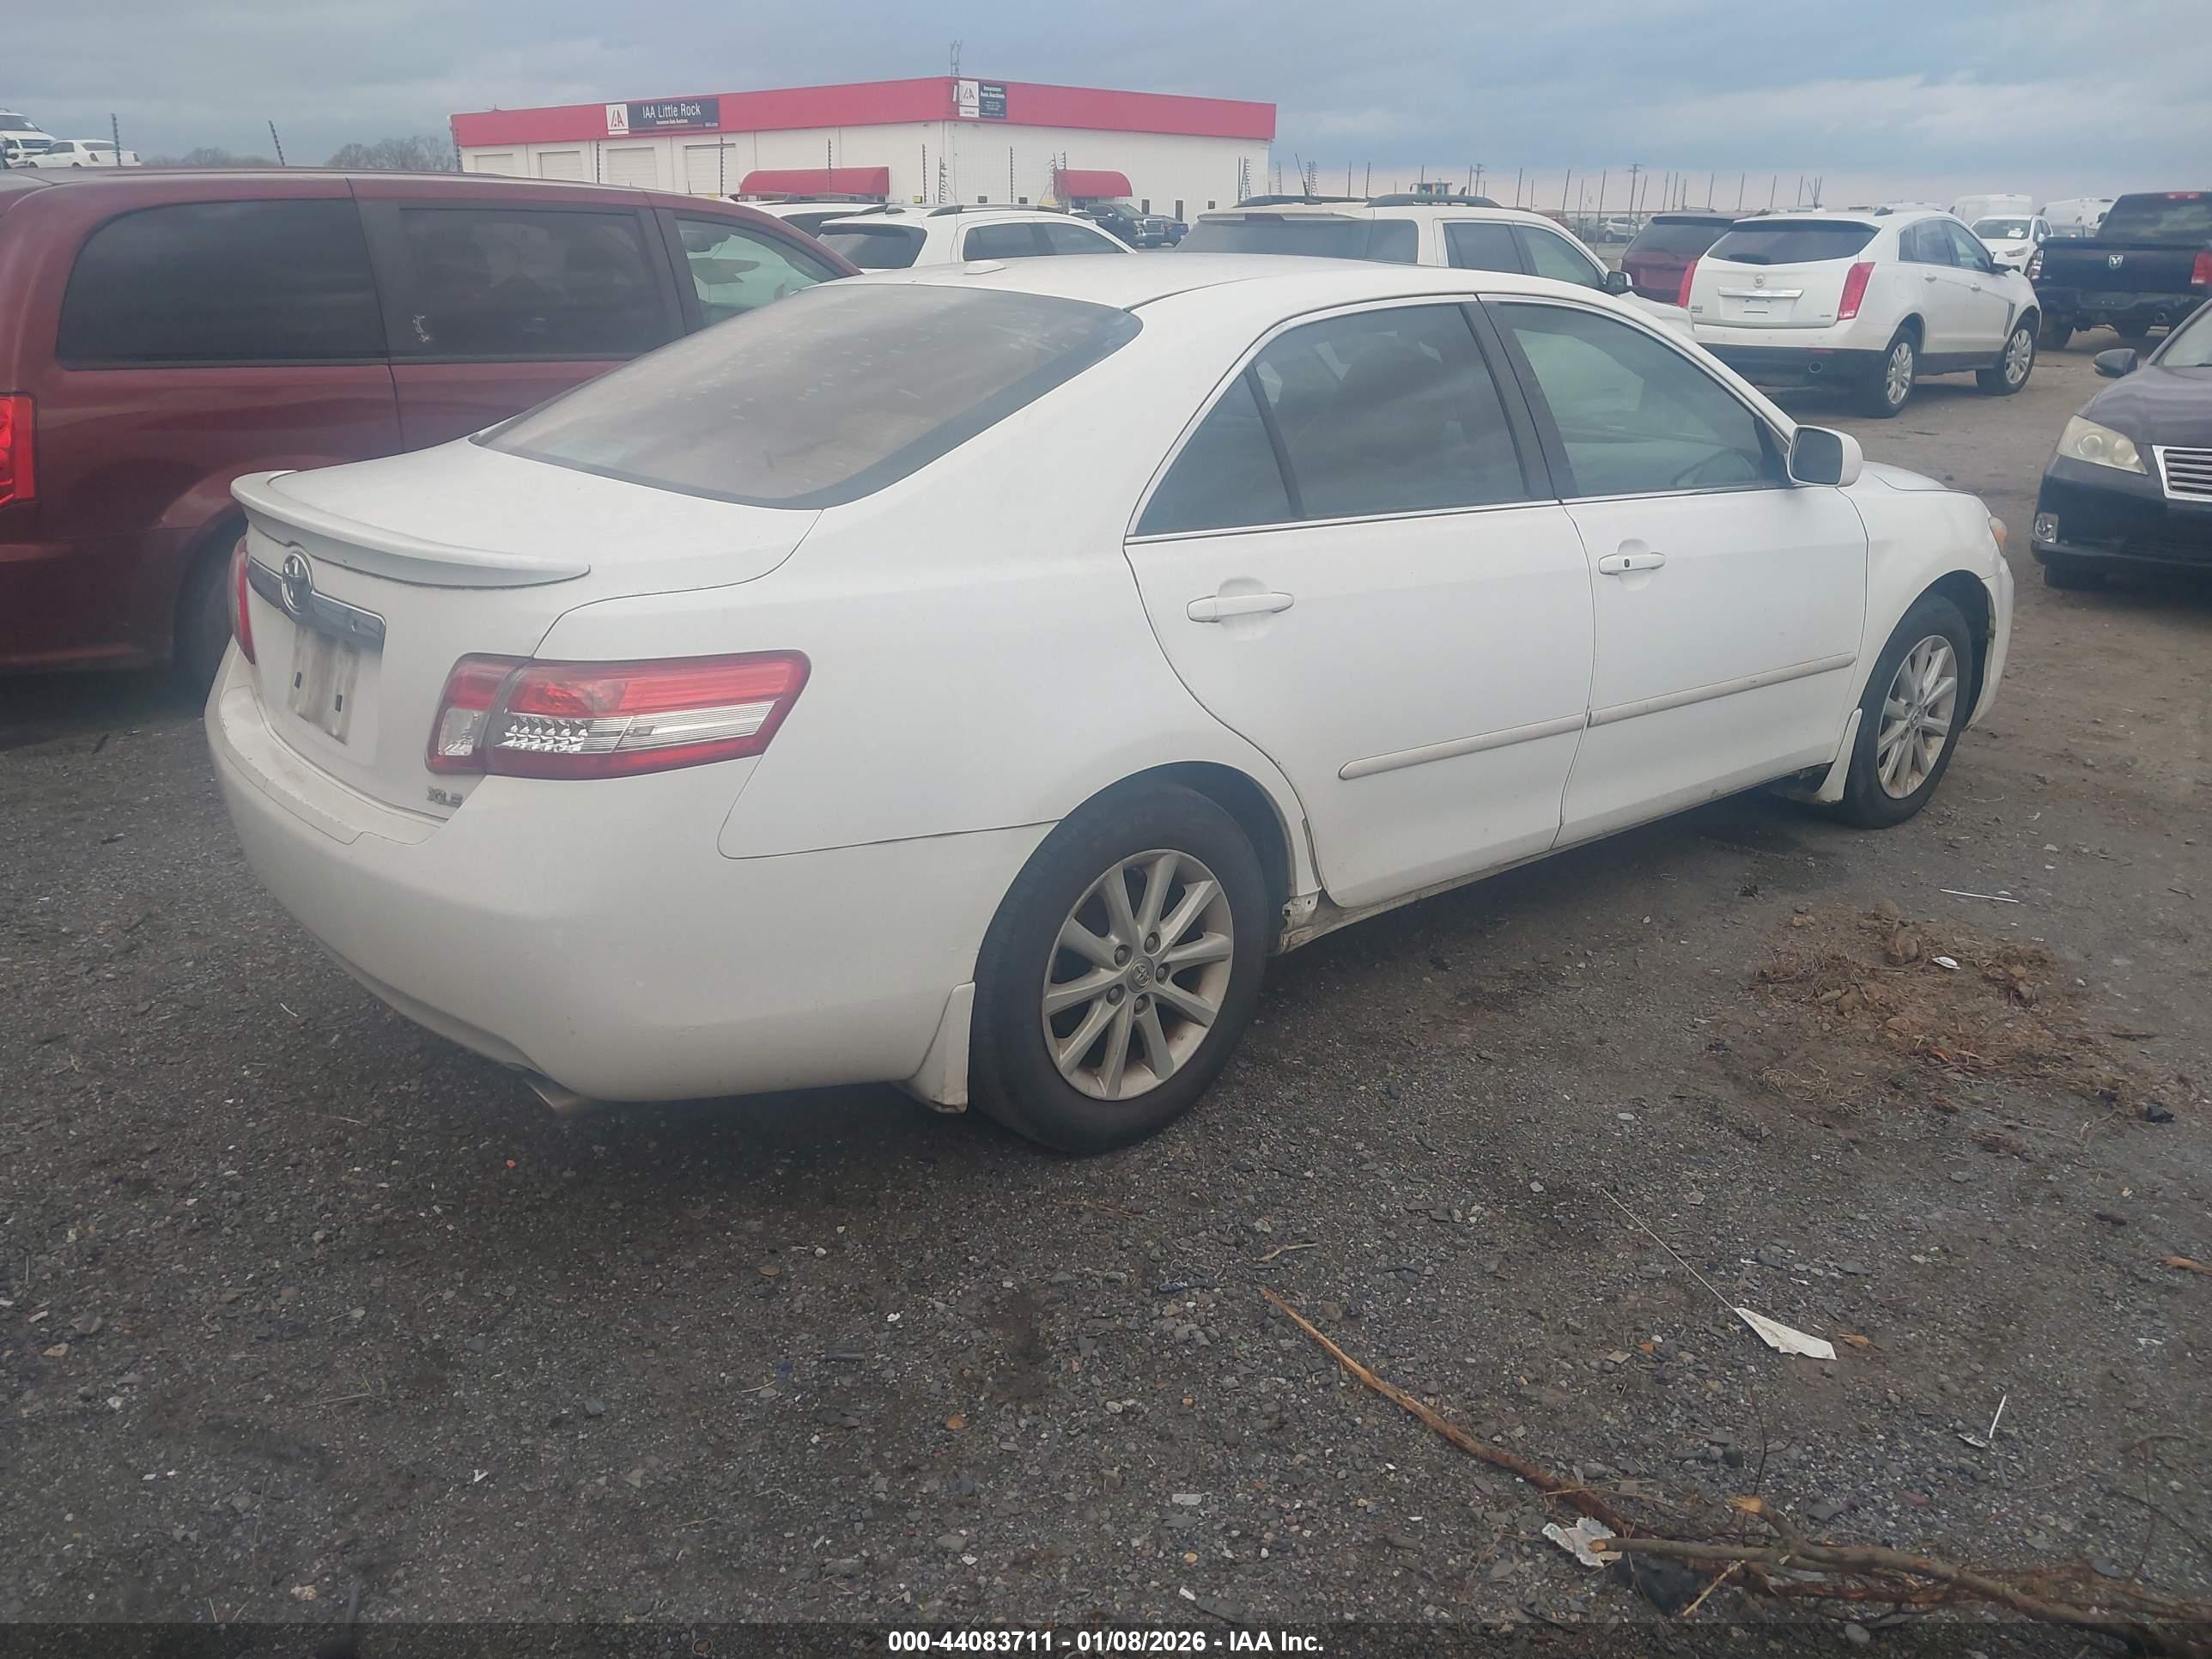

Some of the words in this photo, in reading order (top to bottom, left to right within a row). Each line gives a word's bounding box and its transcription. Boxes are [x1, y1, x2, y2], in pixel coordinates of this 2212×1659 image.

[642, 106, 656, 118] IAA
[658, 104, 678, 118] Little
[681, 102, 702, 117] Rock
